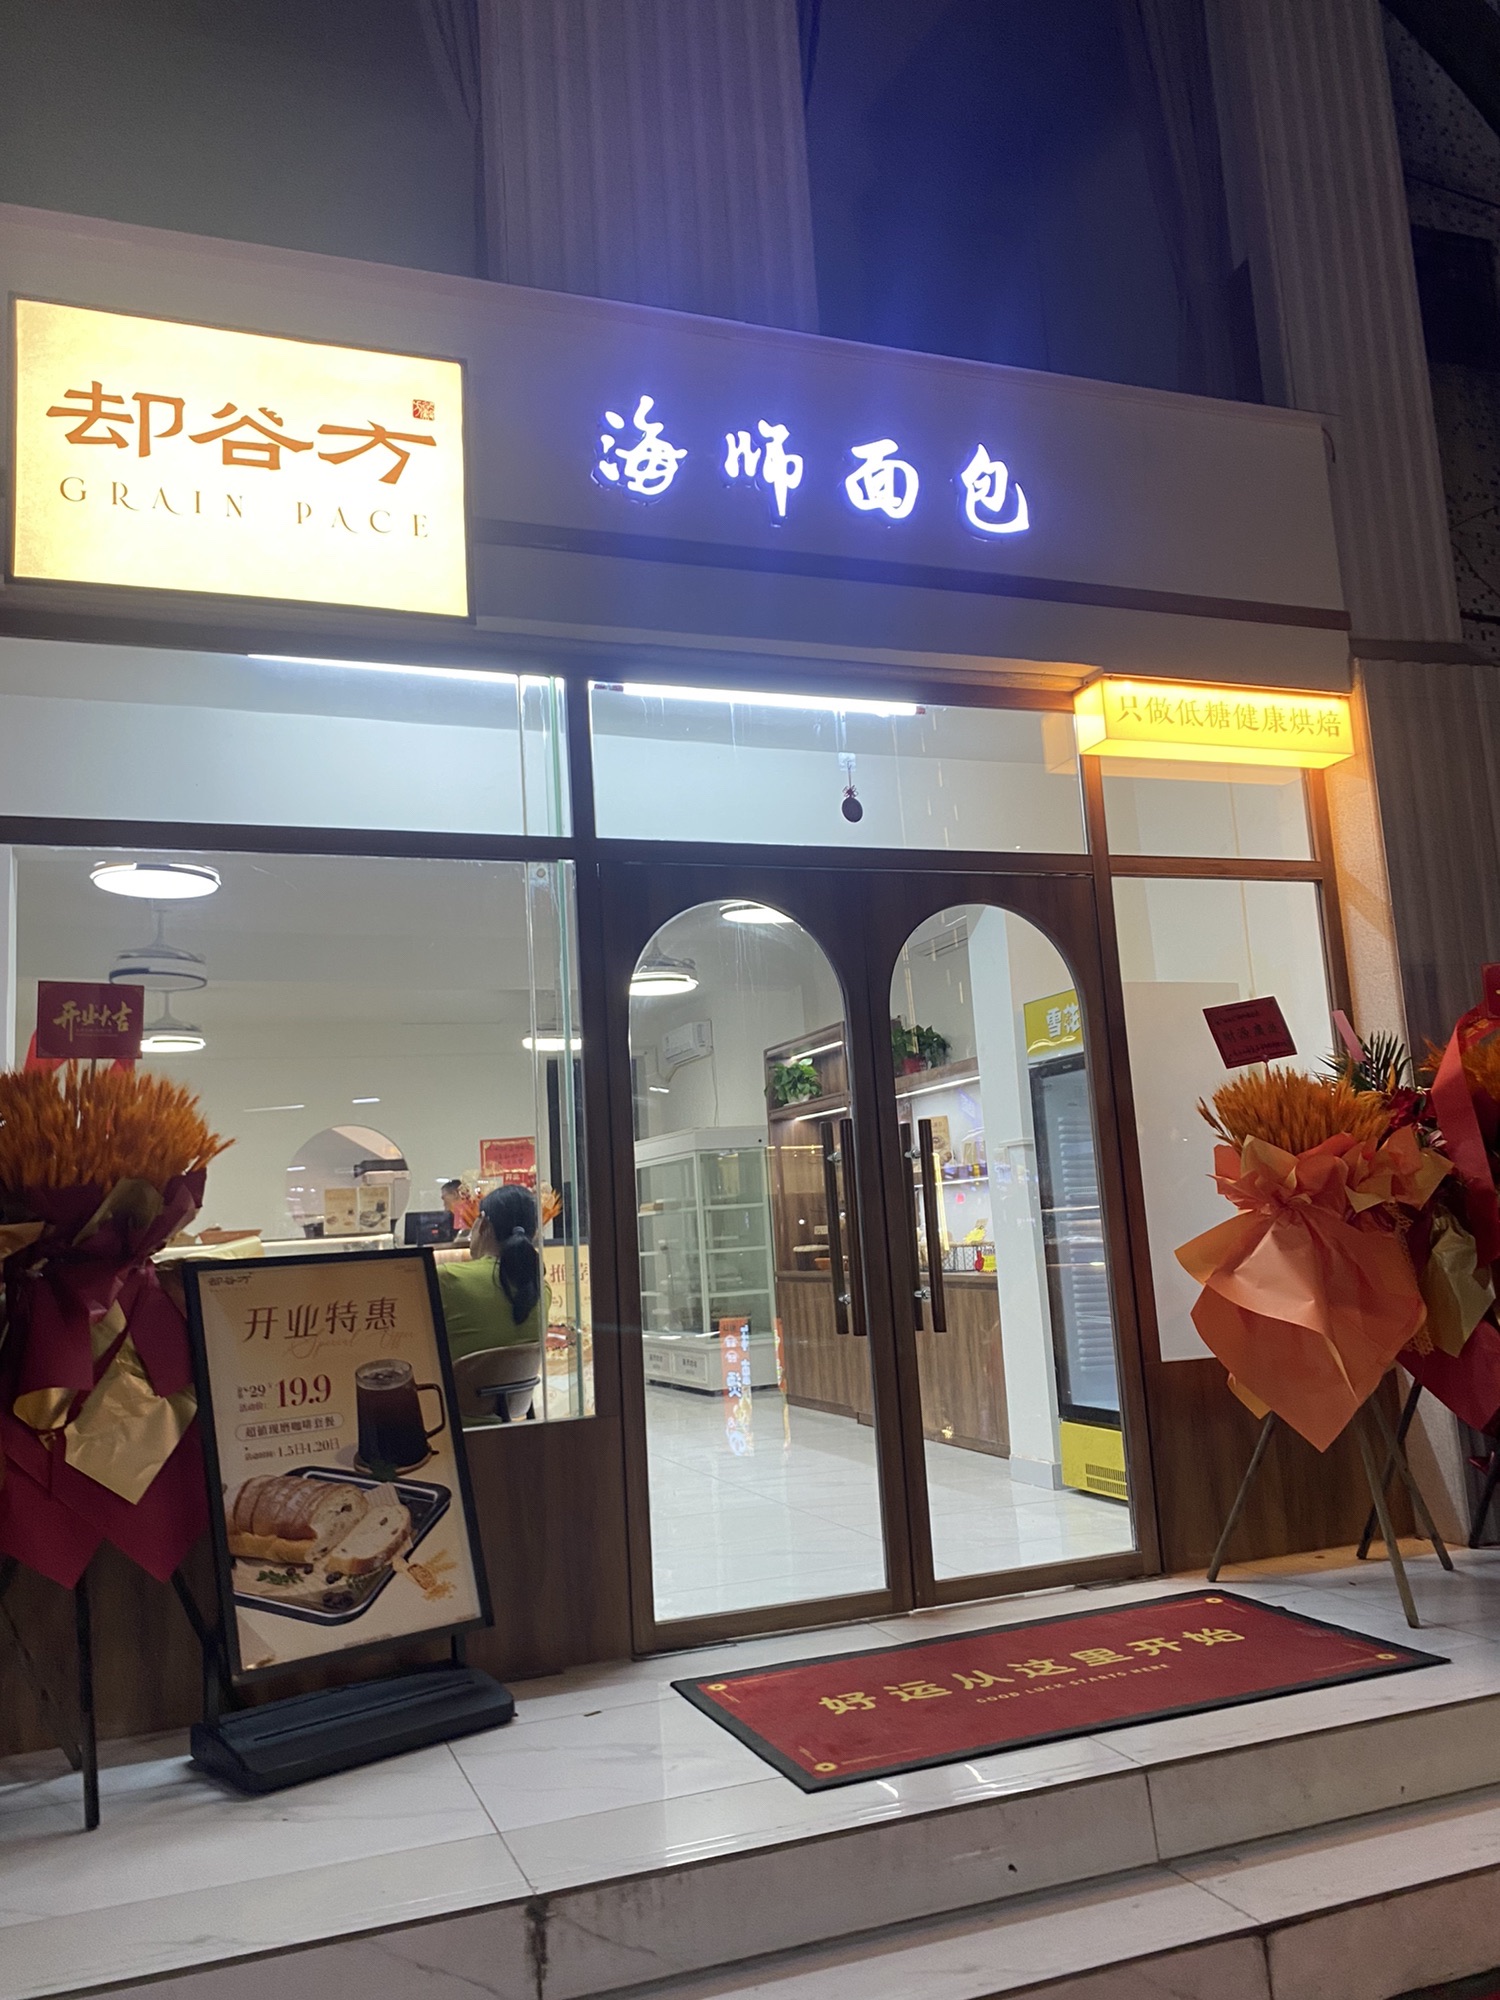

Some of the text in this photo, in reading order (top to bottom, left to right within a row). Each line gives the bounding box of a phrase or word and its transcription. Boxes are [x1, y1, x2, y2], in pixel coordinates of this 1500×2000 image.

[46, 380, 437, 485] 却谷方
[599, 394, 1031, 534] 海师面包
[59, 476, 430, 539] GRAIN PACE
[1116, 695, 1342, 738] 只做低糖健康烘焙
[52, 1000, 133, 1043] 开业大吉
[243, 1296, 399, 1343] 开业特惠
[818, 1626, 1246, 1716] 好运从这里开始
[976, 1663, 1171, 1704] GOOD LUCK STARTS HERE
